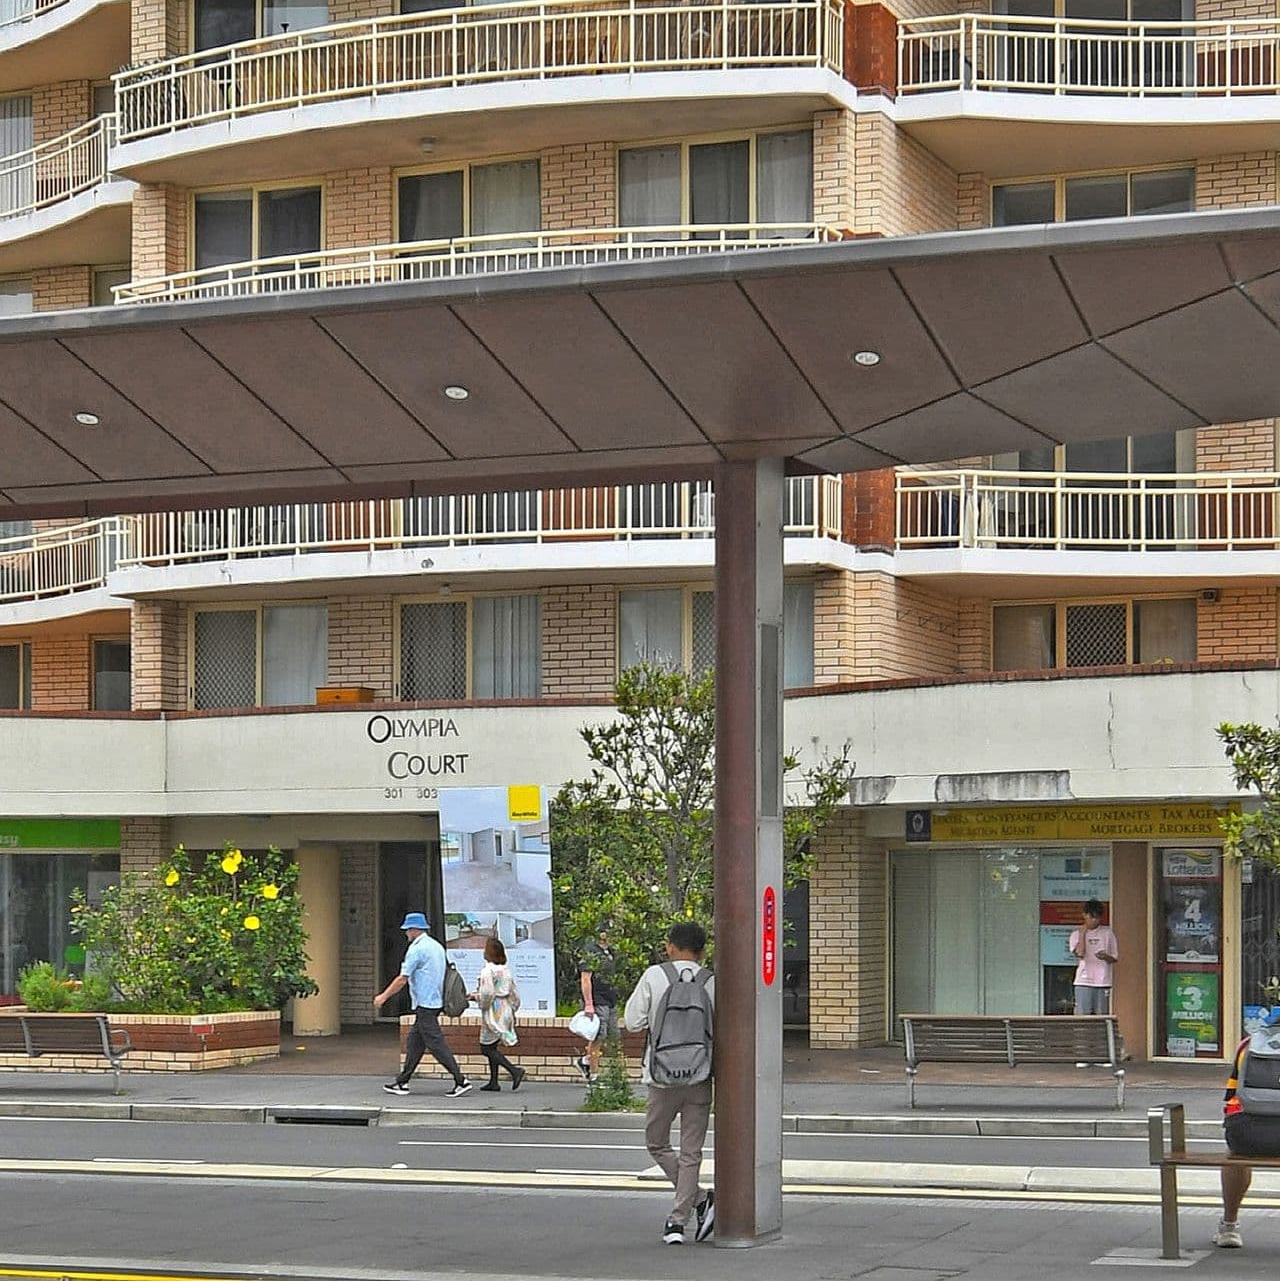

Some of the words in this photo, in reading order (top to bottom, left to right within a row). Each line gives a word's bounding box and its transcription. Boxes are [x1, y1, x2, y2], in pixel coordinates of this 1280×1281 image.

[367, 715, 460, 743] OLYMPIA
[387, 751, 469, 780] COURT
[384, 788, 404, 799] 301
[1062, 808, 1151, 822] ACCOUNTANTS
[1161, 808, 1183, 819] TAX
[1091, 823, 1153, 835] MORTGAGE
[1158, 822, 1212, 834] BROKERS
[1171, 1010, 1214, 1021] MILLION
